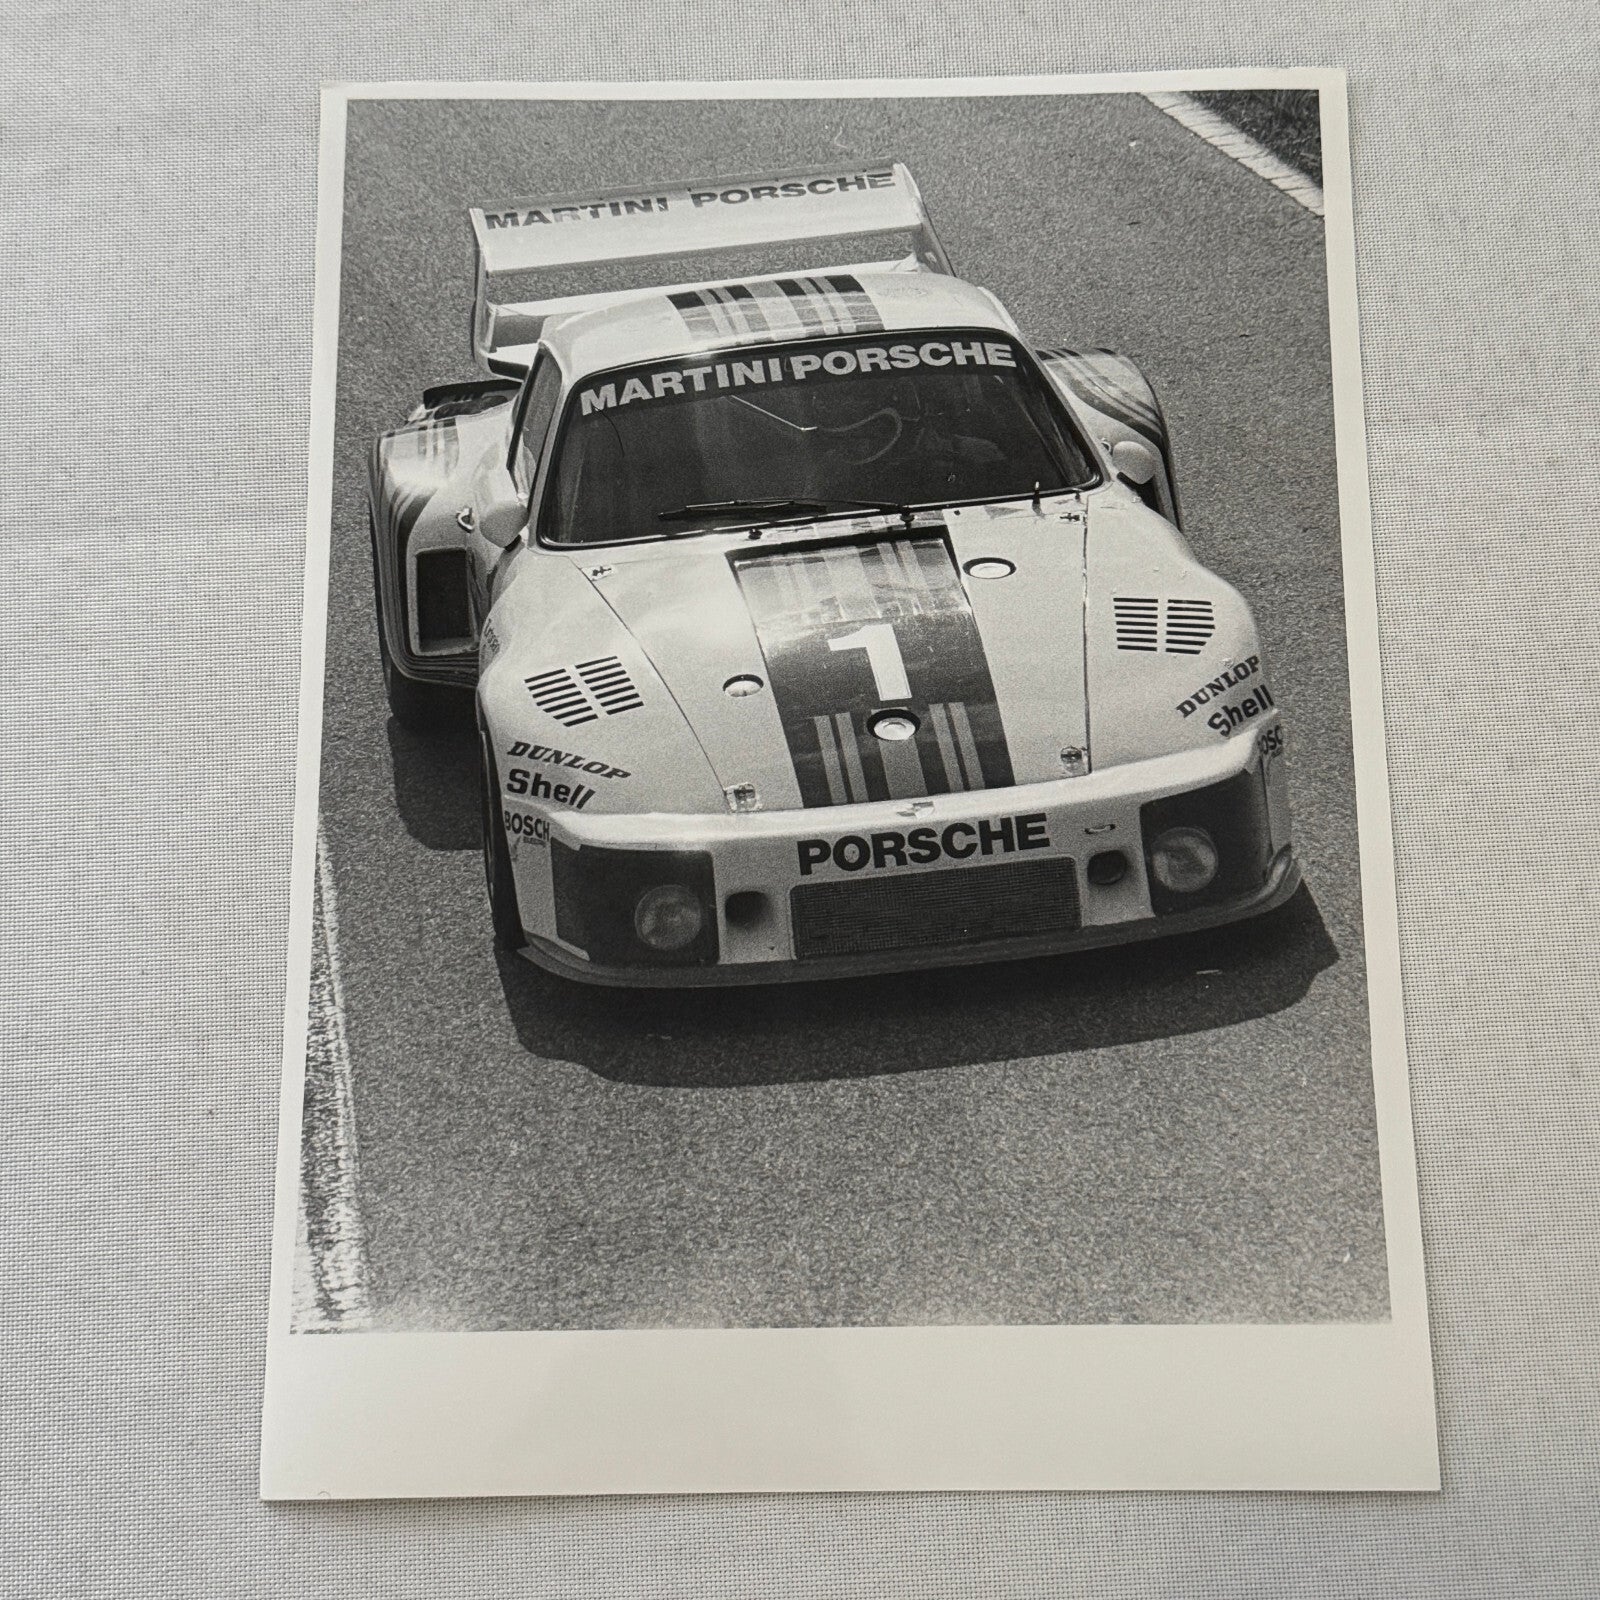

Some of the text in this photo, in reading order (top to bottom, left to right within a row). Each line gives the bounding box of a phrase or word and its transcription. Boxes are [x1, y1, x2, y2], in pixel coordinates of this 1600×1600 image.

[485, 171, 897, 230] MARTINI PORSCHE
[580, 341, 1018, 416] MARTINI PORSCHE
[827, 623, 912, 702] 1
[1175, 655, 1260, 718] DUNLOP
[1207, 684, 1274, 737] Shell
[506, 768, 596, 810] Shell
[507, 741, 631, 780] DUNLOP
[504, 810, 550, 842] BOSCH
[797, 812, 1050, 876] PORSCHE
